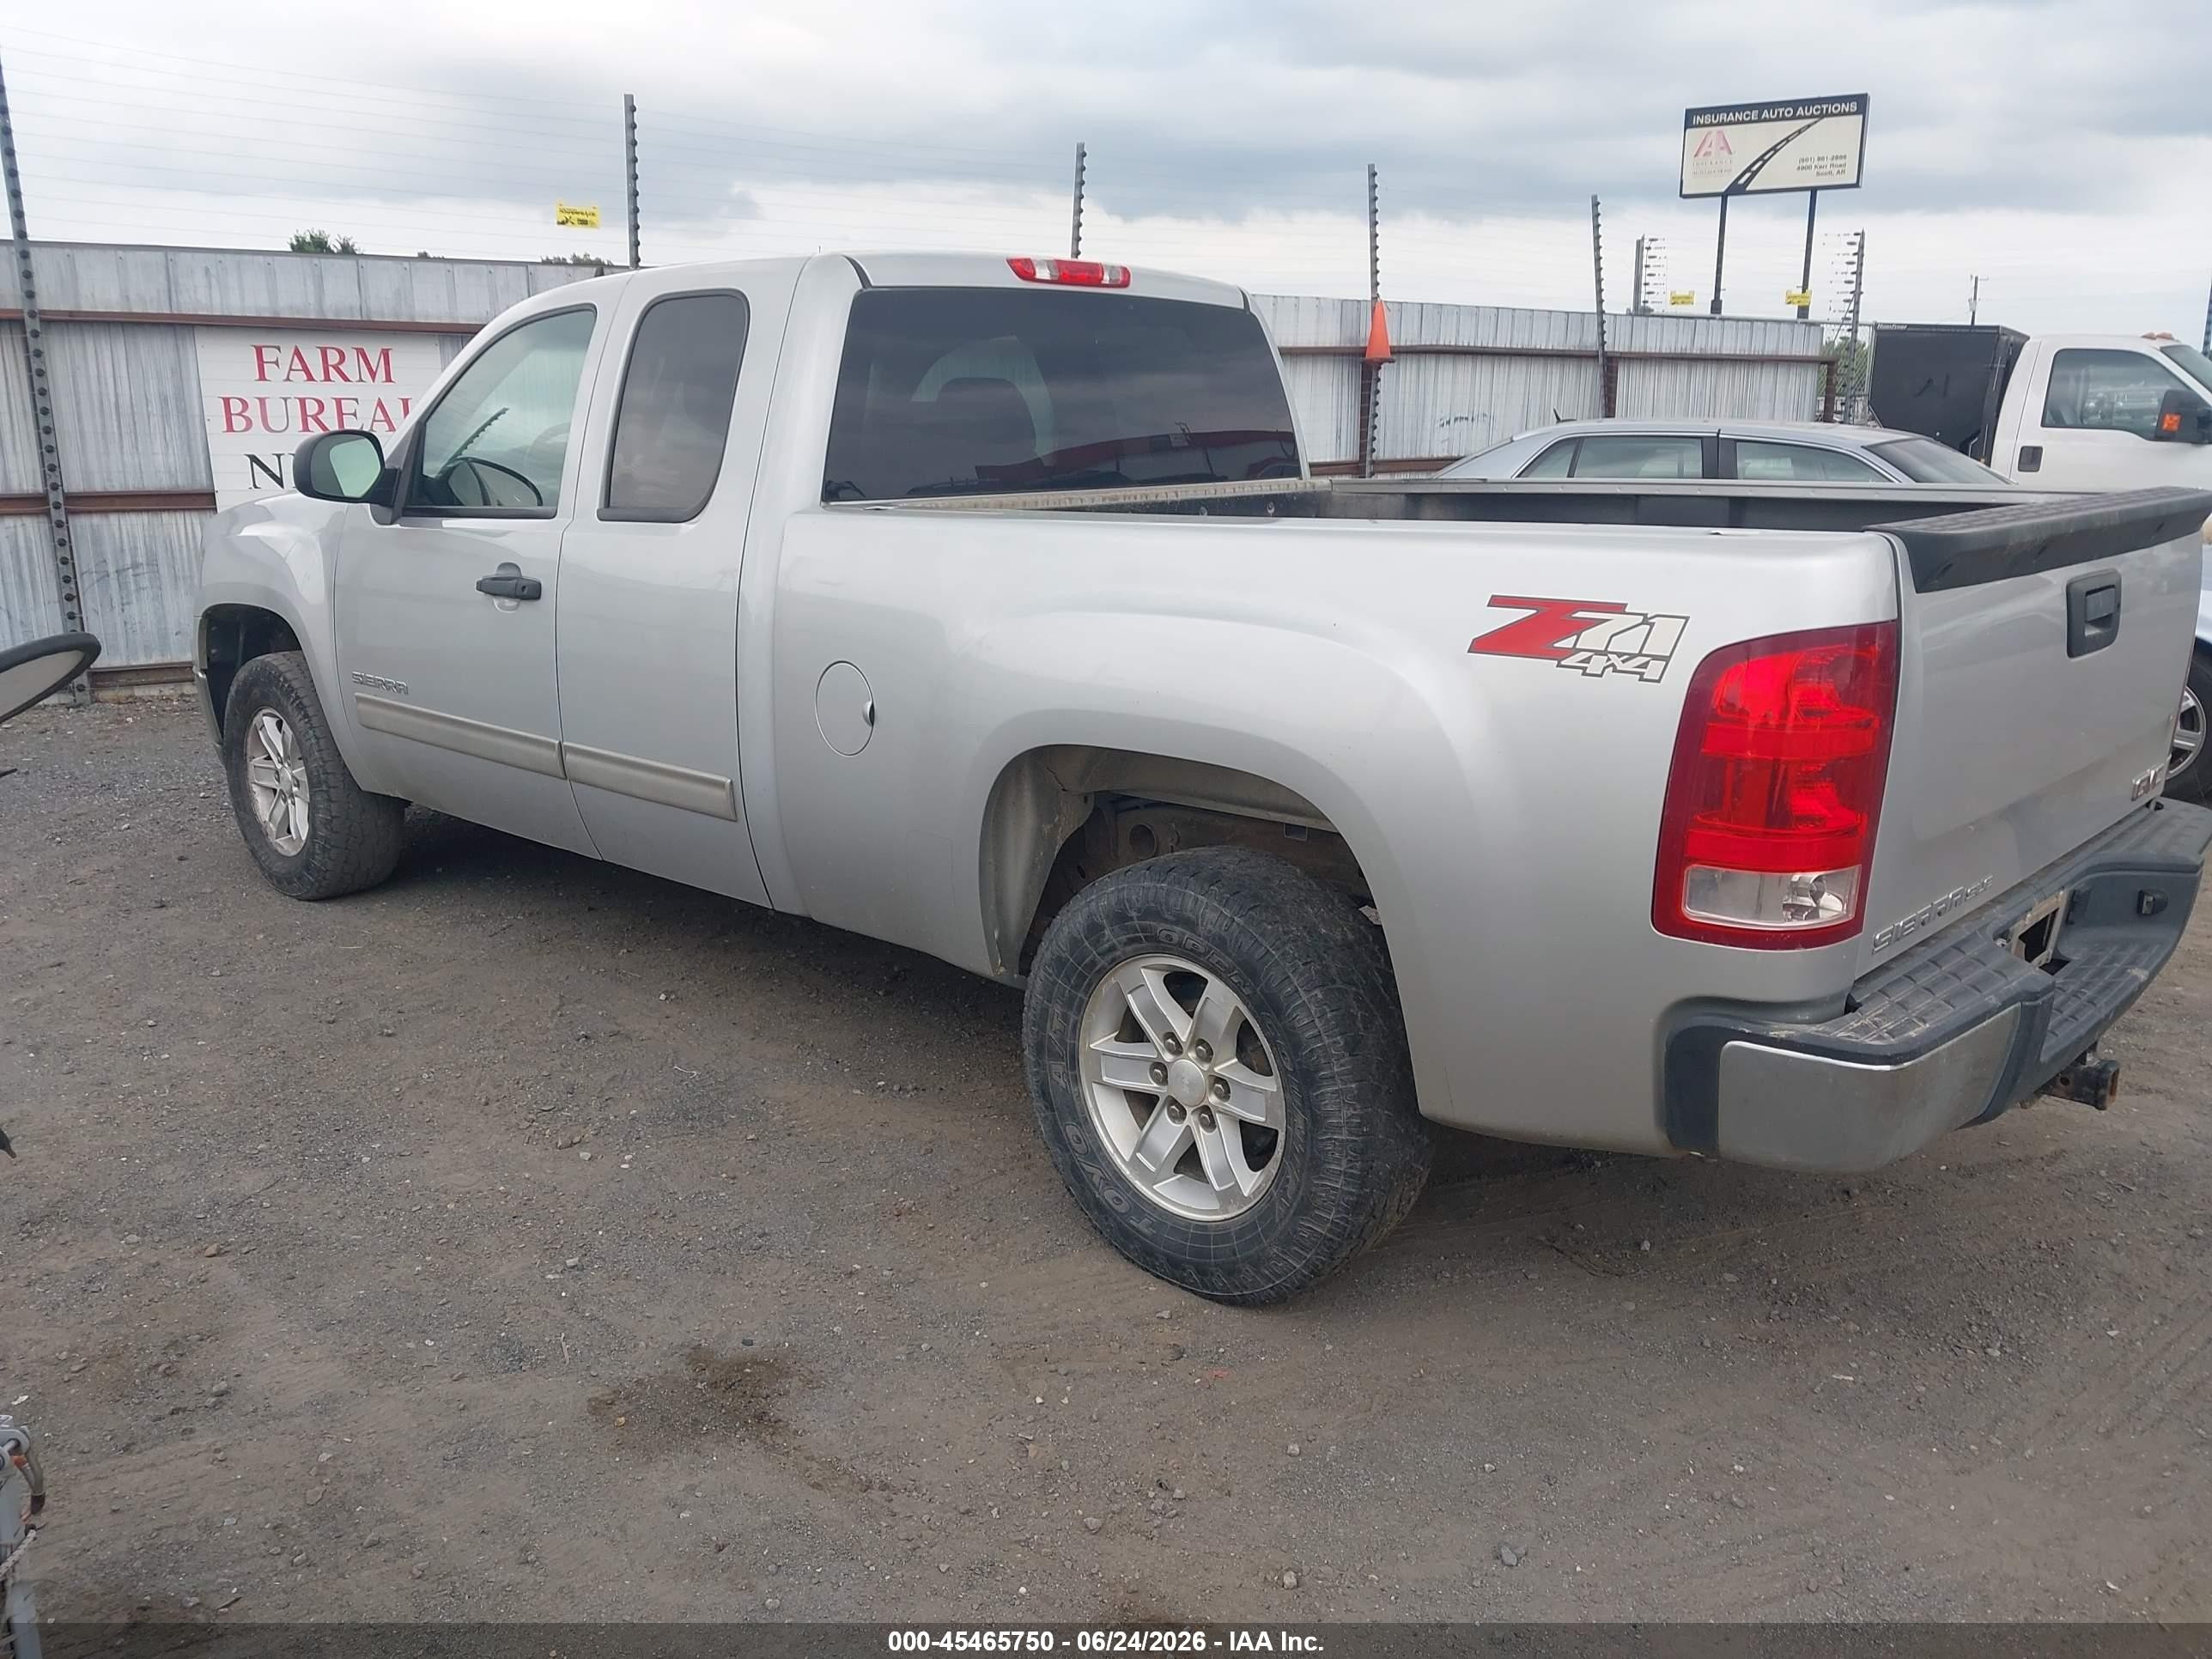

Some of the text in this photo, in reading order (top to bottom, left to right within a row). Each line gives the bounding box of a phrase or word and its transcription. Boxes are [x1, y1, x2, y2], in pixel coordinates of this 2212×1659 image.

[1692, 101, 1857, 125] INSURANCE AUTO AUCTIONS
[251, 344, 396, 383] FARM
[1467, 594, 1690, 661] Z71
[352, 671, 409, 696] SIERRA
[1872, 885, 1966, 955] SIERRA
